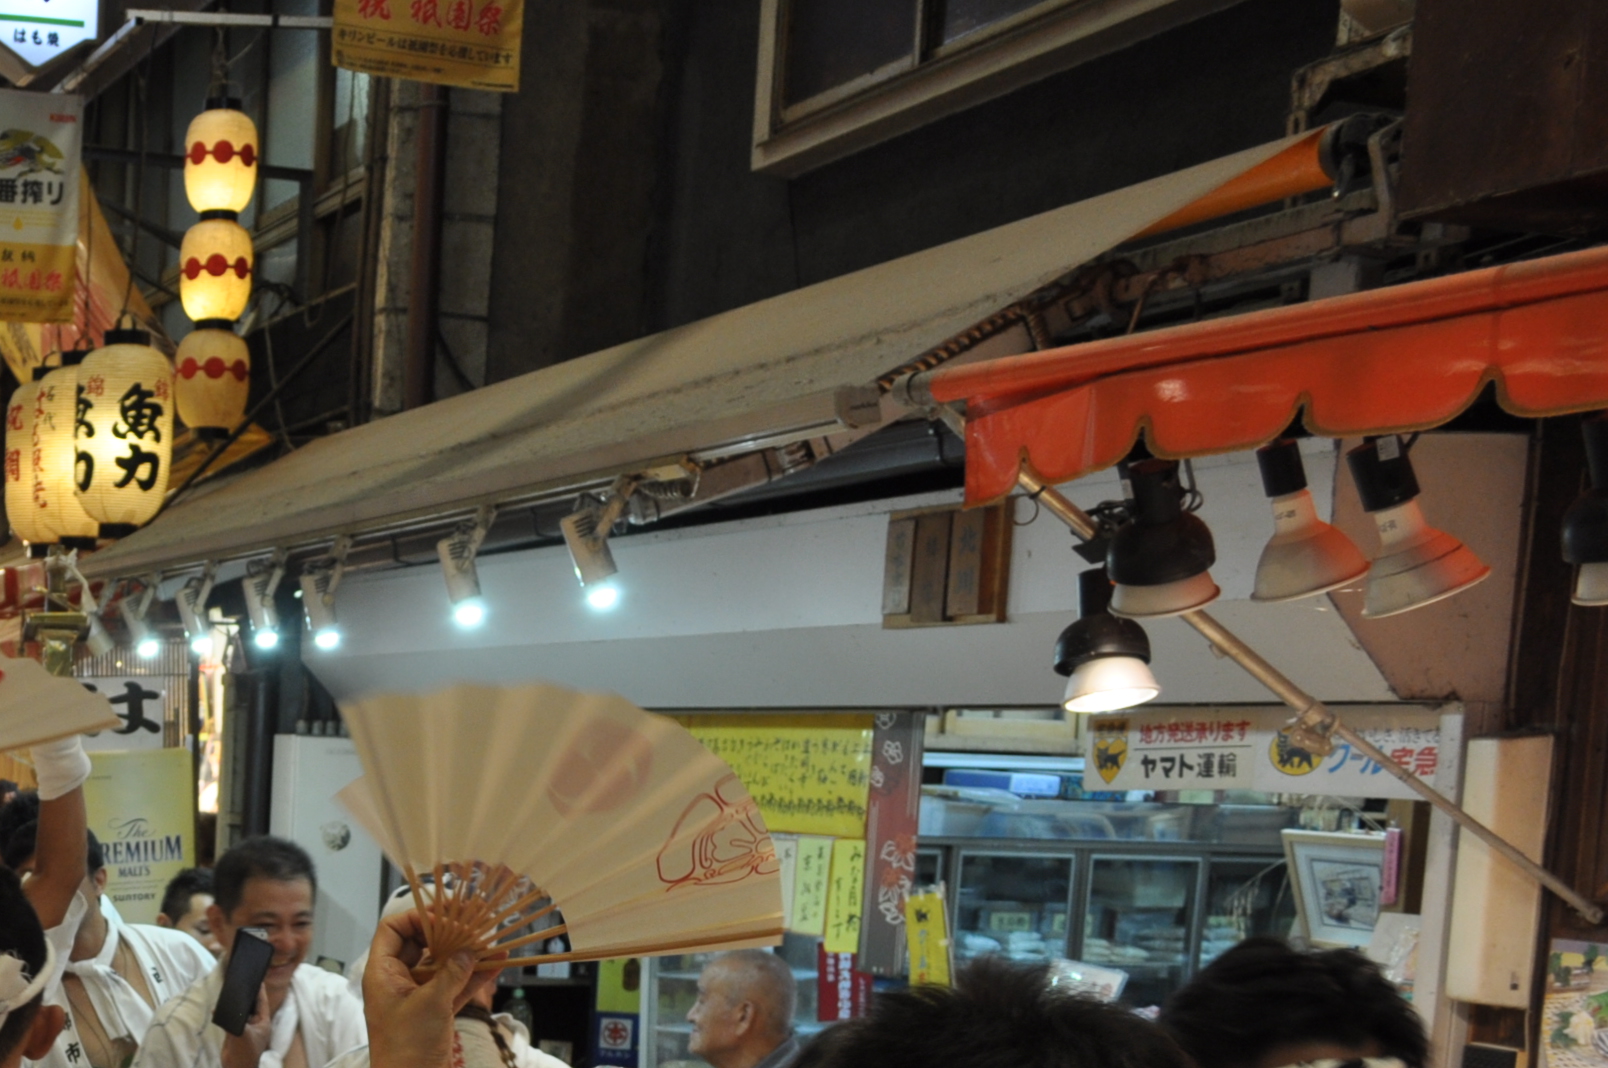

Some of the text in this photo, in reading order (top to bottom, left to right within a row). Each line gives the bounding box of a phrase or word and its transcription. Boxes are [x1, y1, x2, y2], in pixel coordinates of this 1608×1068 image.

[410, 0, 503, 37] 祇園祭
[1, 266, 64, 292] 祇園祭
[112, 382, 164, 492] 魚力
[1139, 720, 1252, 745] 地方発送承ります
[1140, 752, 1238, 779] ヤマト運輸
[99, 834, 183, 865] REMIUM
